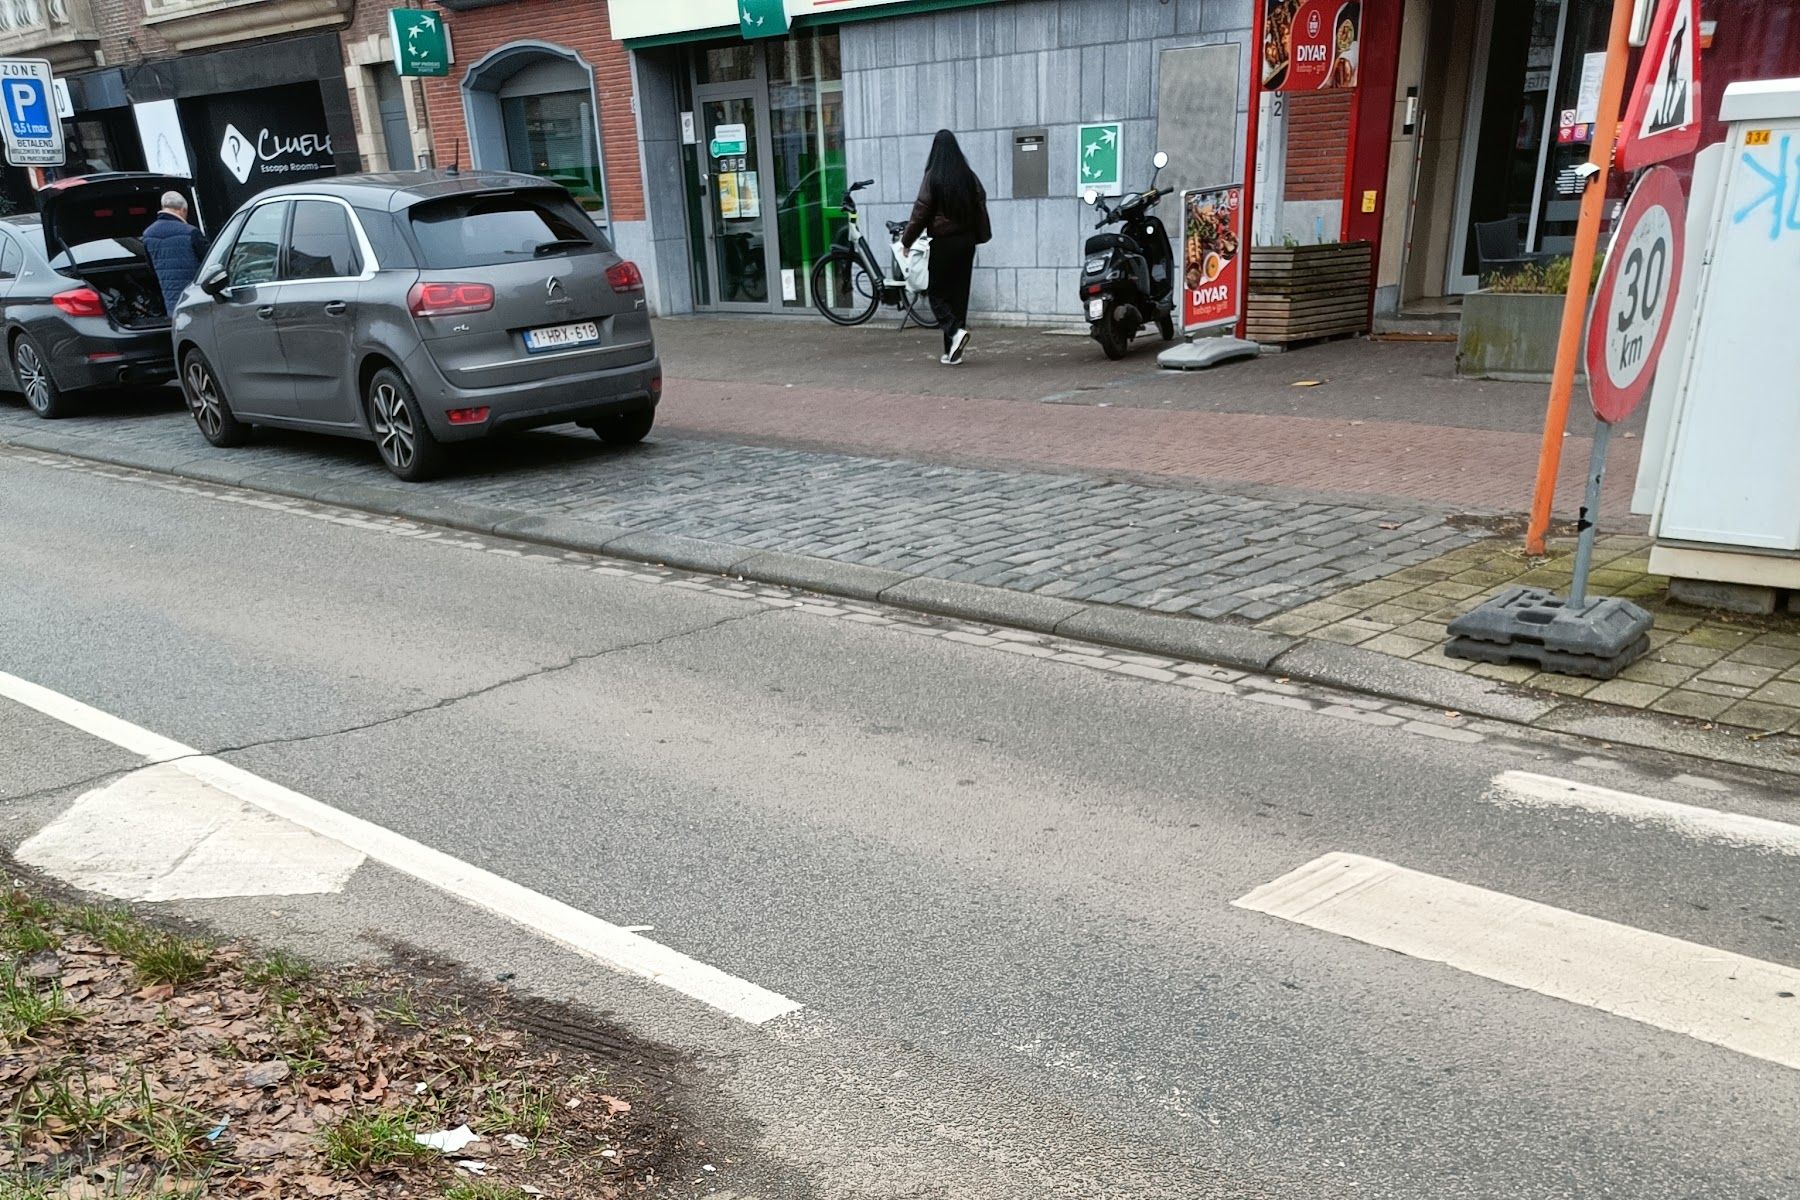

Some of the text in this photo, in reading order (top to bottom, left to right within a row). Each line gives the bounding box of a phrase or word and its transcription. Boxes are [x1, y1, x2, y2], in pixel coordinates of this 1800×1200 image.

[1297, 45, 1326, 61] DIYAR
[3, 65, 38, 76] ZONE
[11, 84, 36, 121] P
[32, 125, 49, 133] max
[17, 140, 54, 148] BETALEND
[261, 162, 320, 173] Escape Rooms
[1618, 237, 1666, 332] 30
[1193, 285, 1228, 306] DIYAR
[1619, 334, 1643, 370] km
